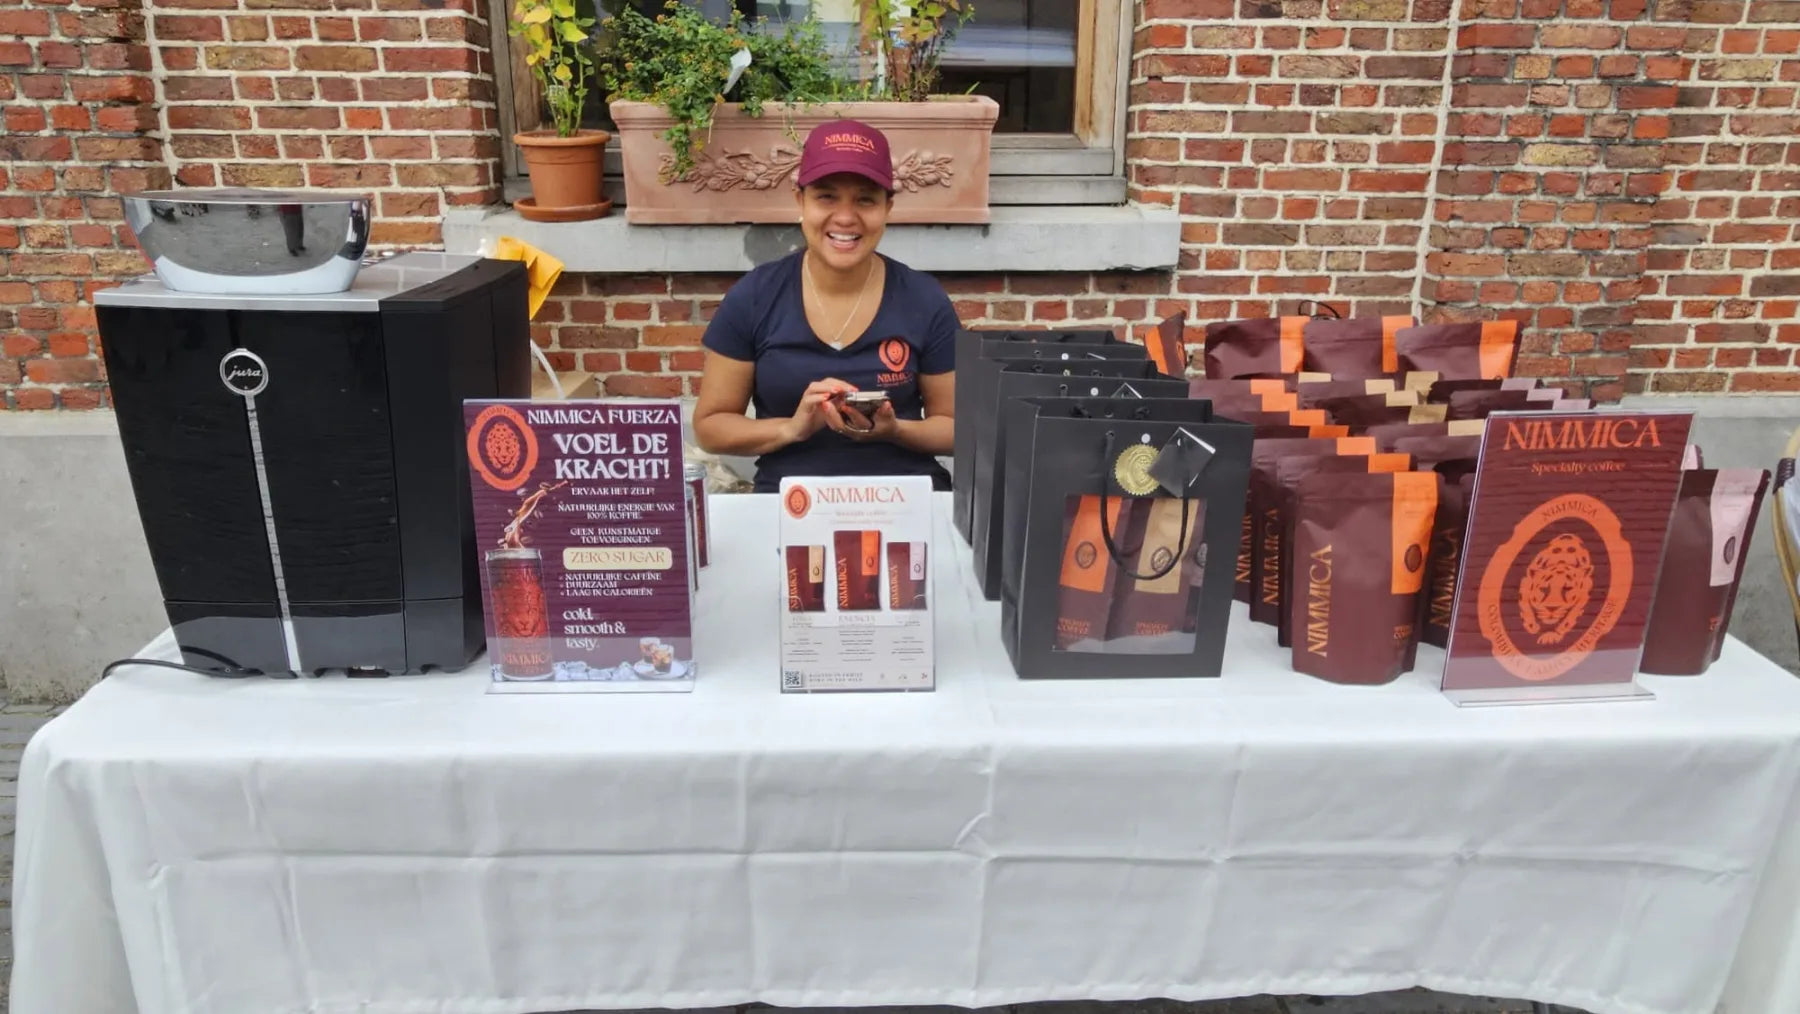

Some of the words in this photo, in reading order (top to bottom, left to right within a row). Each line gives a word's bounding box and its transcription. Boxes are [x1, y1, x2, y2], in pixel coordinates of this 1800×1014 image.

[824, 133, 875, 149] NIMMICA
[227, 364, 263, 381] jura
[527, 409, 605, 424] NIMMICA
[608, 410, 679, 424] FUERZA
[1503, 419, 1662, 449] NIMMICA
[553, 433, 626, 454] VOEL
[632, 433, 669, 454] DE
[554, 459, 671, 479] KRACHT!
[1531, 461, 1586, 476] Specialty
[1587, 460, 1627, 473] coffee
[571, 487, 609, 495] ERVAAR
[611, 487, 628, 495] HET
[816, 486, 905, 504] NIMMICA
[558, 504, 616, 512] NATUURLIJKE
[617, 503, 654, 511] ENERGIE
[656, 503, 675, 511] VAN
[1541, 500, 1599, 521] NIMMICA
[598, 527, 661, 535] KUNSTMATIGE
[571, 551, 610, 563] ZERO
[612, 551, 665, 563] SUGAR
[1262, 507, 1280, 606] NIMMICA
[565, 580, 617, 588] DUURZAAM
[838, 558, 849, 608] NIMMICA
[566, 588, 591, 596] LAAG
[592, 588, 602, 596] IN
[1307, 544, 1333, 658] NIMMICA
[564, 621, 613, 634] smooth
[614, 621, 626, 634] &
